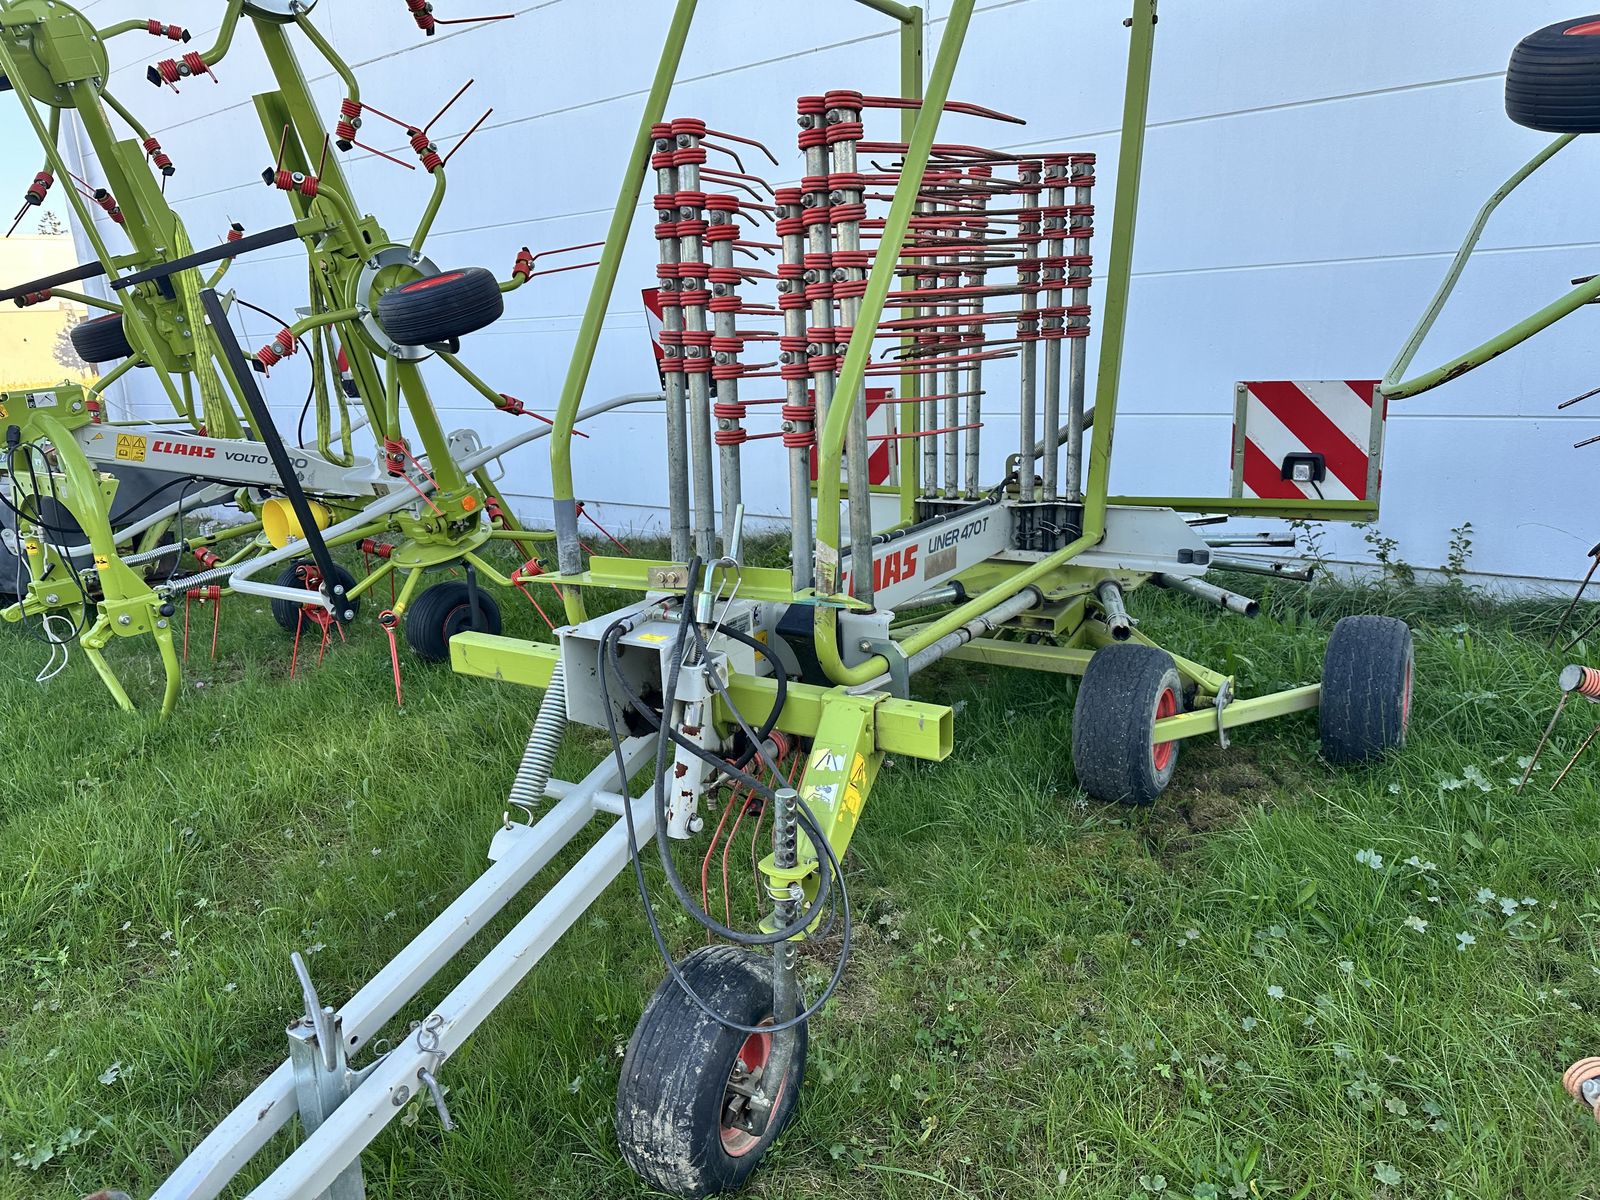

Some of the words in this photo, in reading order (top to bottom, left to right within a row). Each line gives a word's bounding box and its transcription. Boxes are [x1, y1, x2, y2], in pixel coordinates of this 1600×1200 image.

[152, 441, 216, 459] CLAAS
[224, 451, 268, 464] VOLTO
[928, 528, 960, 554] LINER
